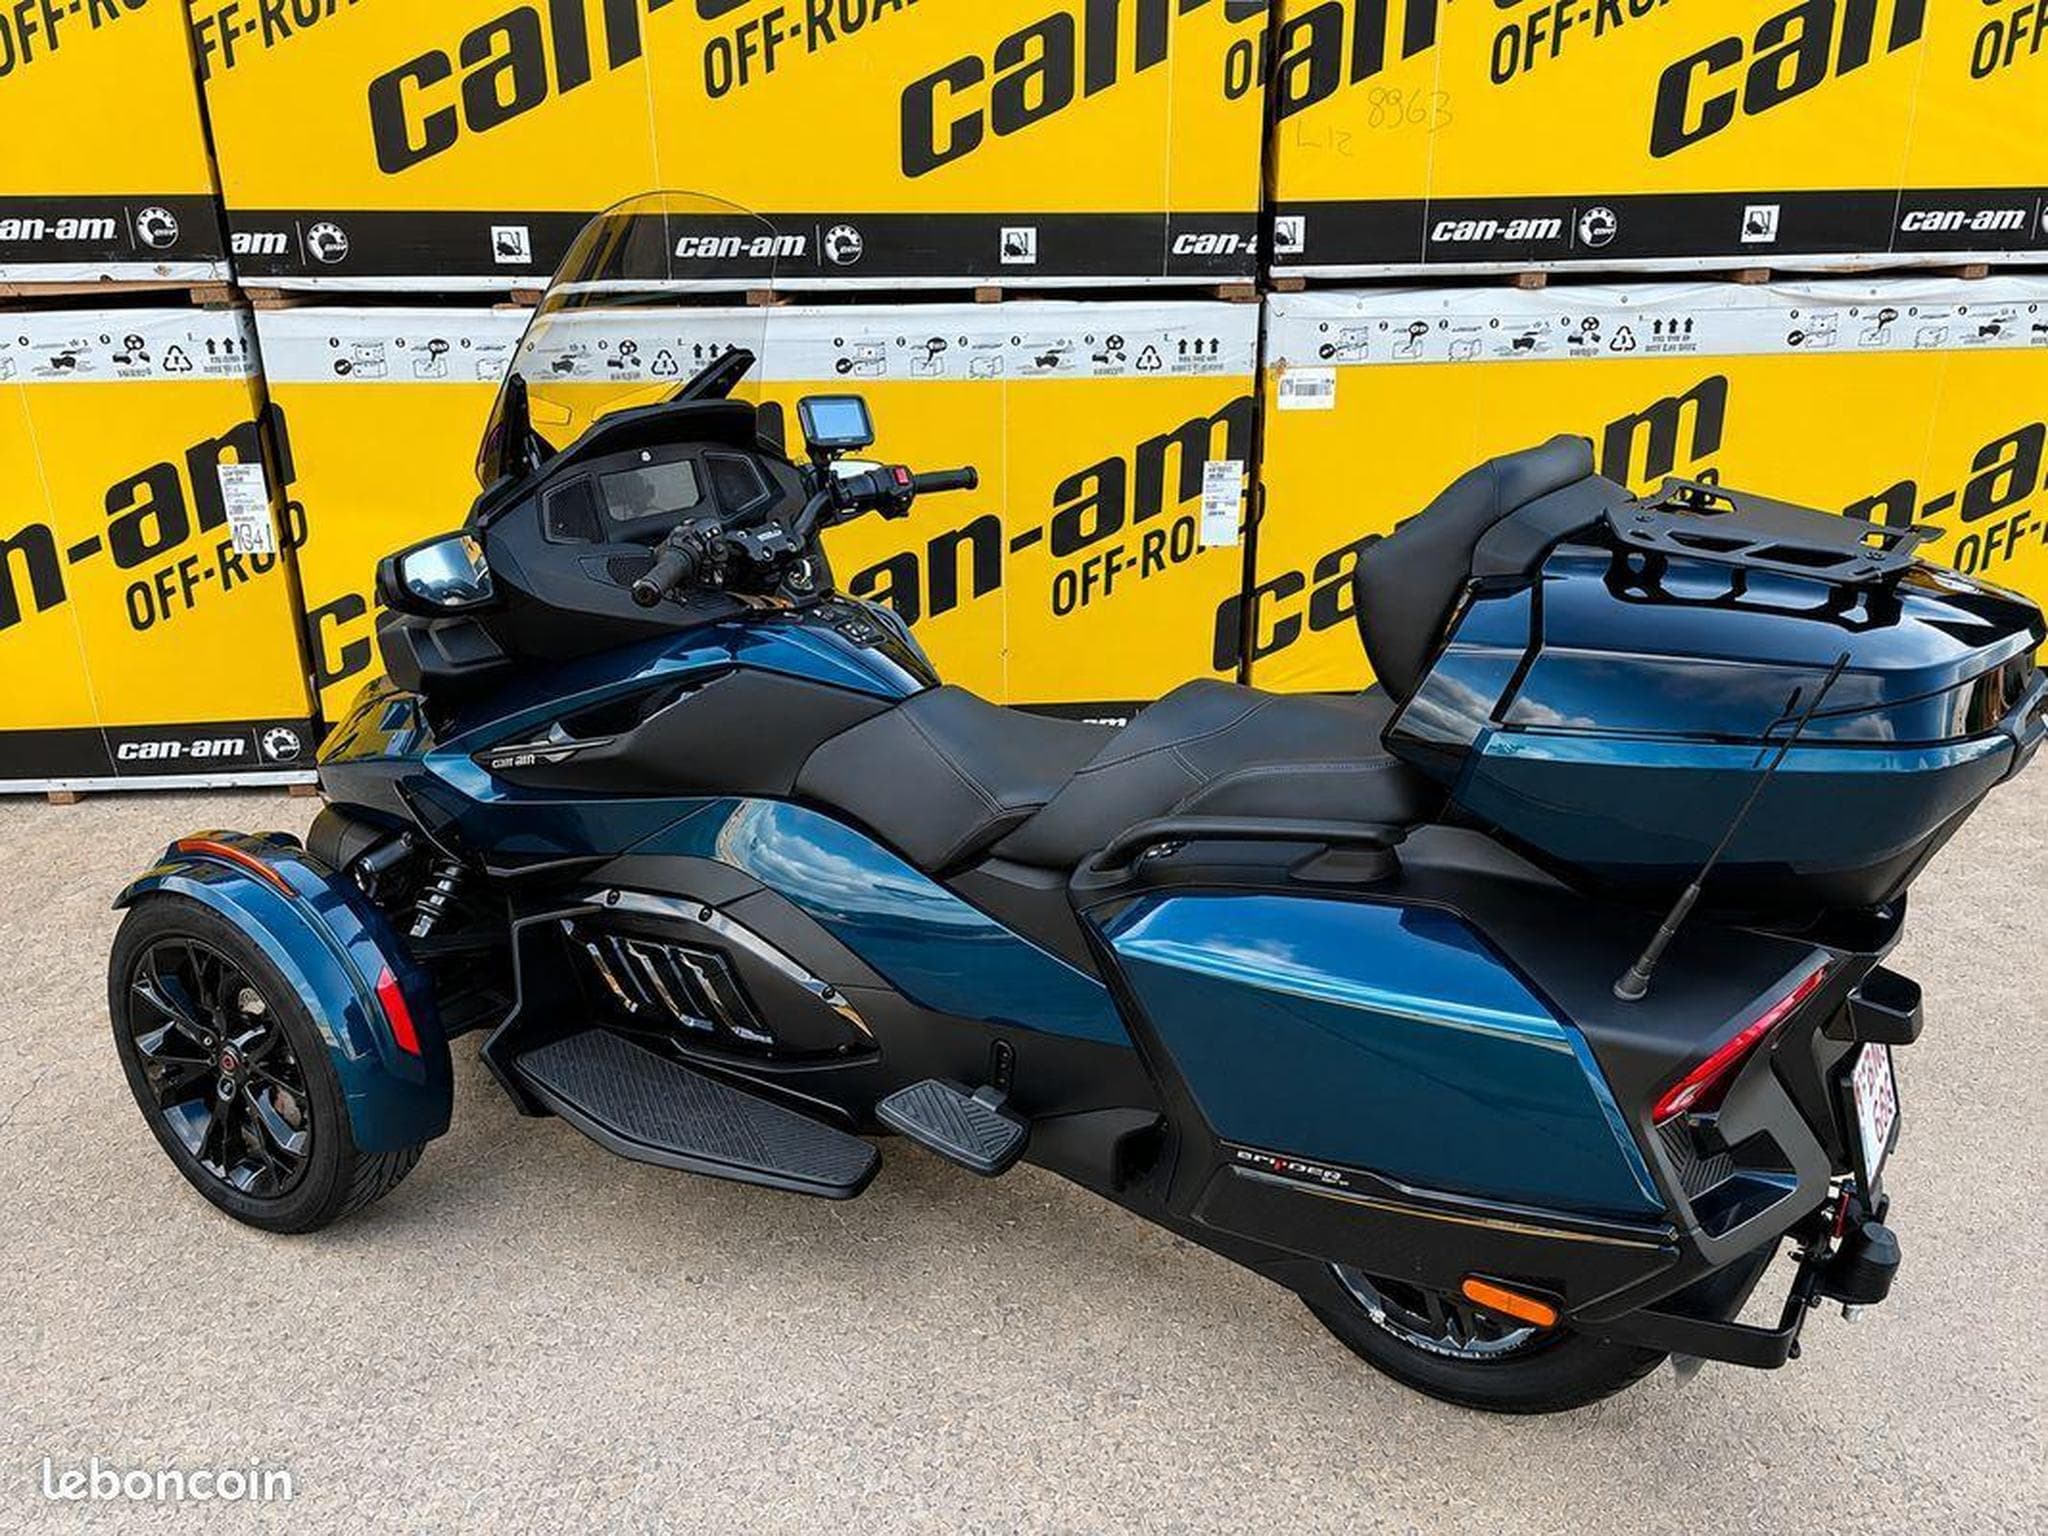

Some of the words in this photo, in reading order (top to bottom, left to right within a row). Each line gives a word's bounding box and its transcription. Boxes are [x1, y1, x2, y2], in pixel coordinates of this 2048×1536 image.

[1431, 218, 1562, 242] can-am
[1900, 209, 2026, 231] can-am
[675, 235, 807, 257] can-am
[117, 738, 245, 760] can-am
